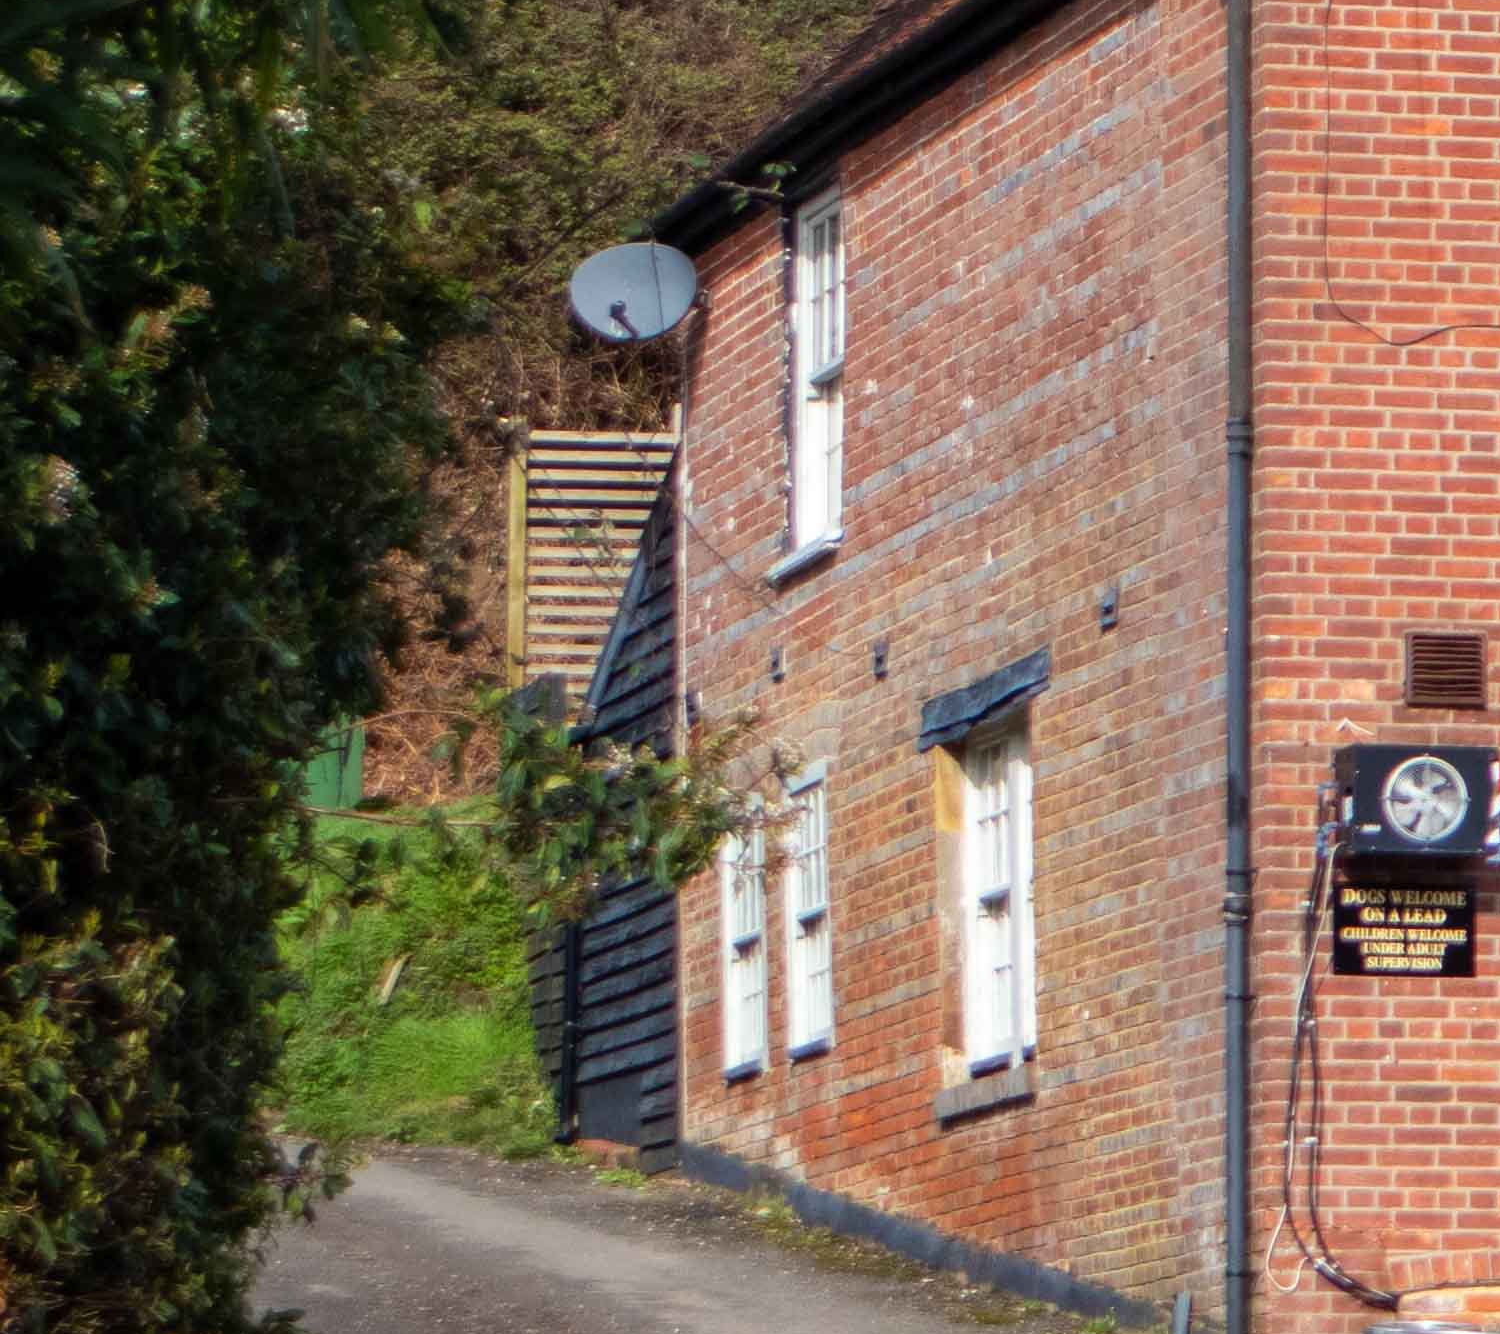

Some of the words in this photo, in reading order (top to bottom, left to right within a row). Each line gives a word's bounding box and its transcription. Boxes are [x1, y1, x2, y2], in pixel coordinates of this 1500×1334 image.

[1342, 888, 1386, 905] DOGS
[1390, 890, 1467, 906] WELCOME
[1361, 907, 1385, 923] ON
[1389, 908, 1400, 923] A
[1403, 908, 1447, 924] LEAD
[1342, 927, 1405, 941] CHILDREN
[1407, 929, 1467, 942] WELCOME
[1362, 942, 1405, 955] UNDER
[1407, 943, 1448, 956] ADULT
[1365, 957, 1442, 970] SUPERVISION
